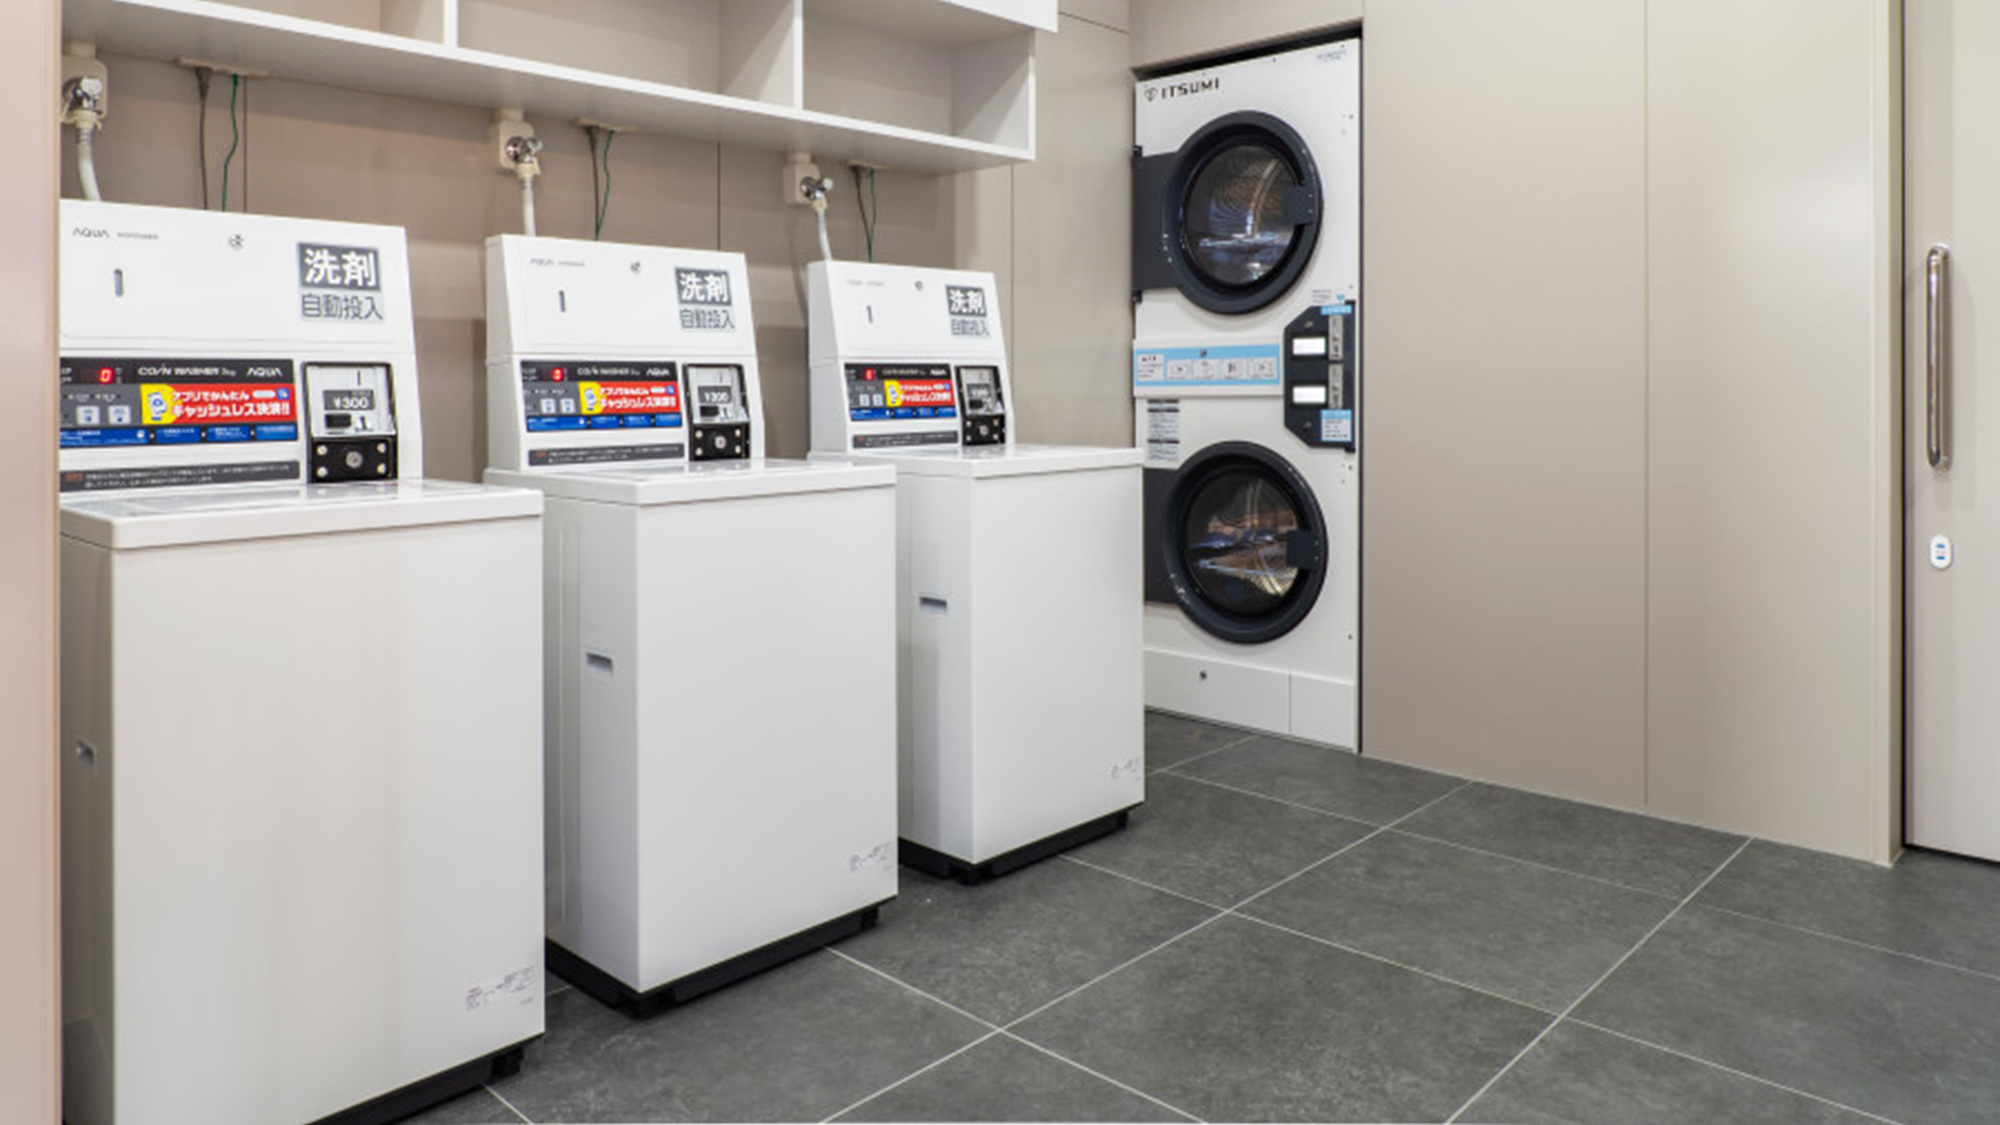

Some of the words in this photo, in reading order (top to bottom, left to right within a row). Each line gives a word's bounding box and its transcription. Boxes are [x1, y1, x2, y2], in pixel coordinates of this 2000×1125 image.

[1161, 77, 1220, 100] ITSUMI
[72, 226, 110, 239] AQUA
[303, 247, 376, 288] 洗剤
[679, 272, 728, 302] 洗剤
[301, 294, 383, 321] 自動投入
[100, 367, 114, 384] 0
[247, 366, 283, 377] AQUA
[646, 367, 670, 377] AQUA
[333, 396, 369, 409] ¥300
